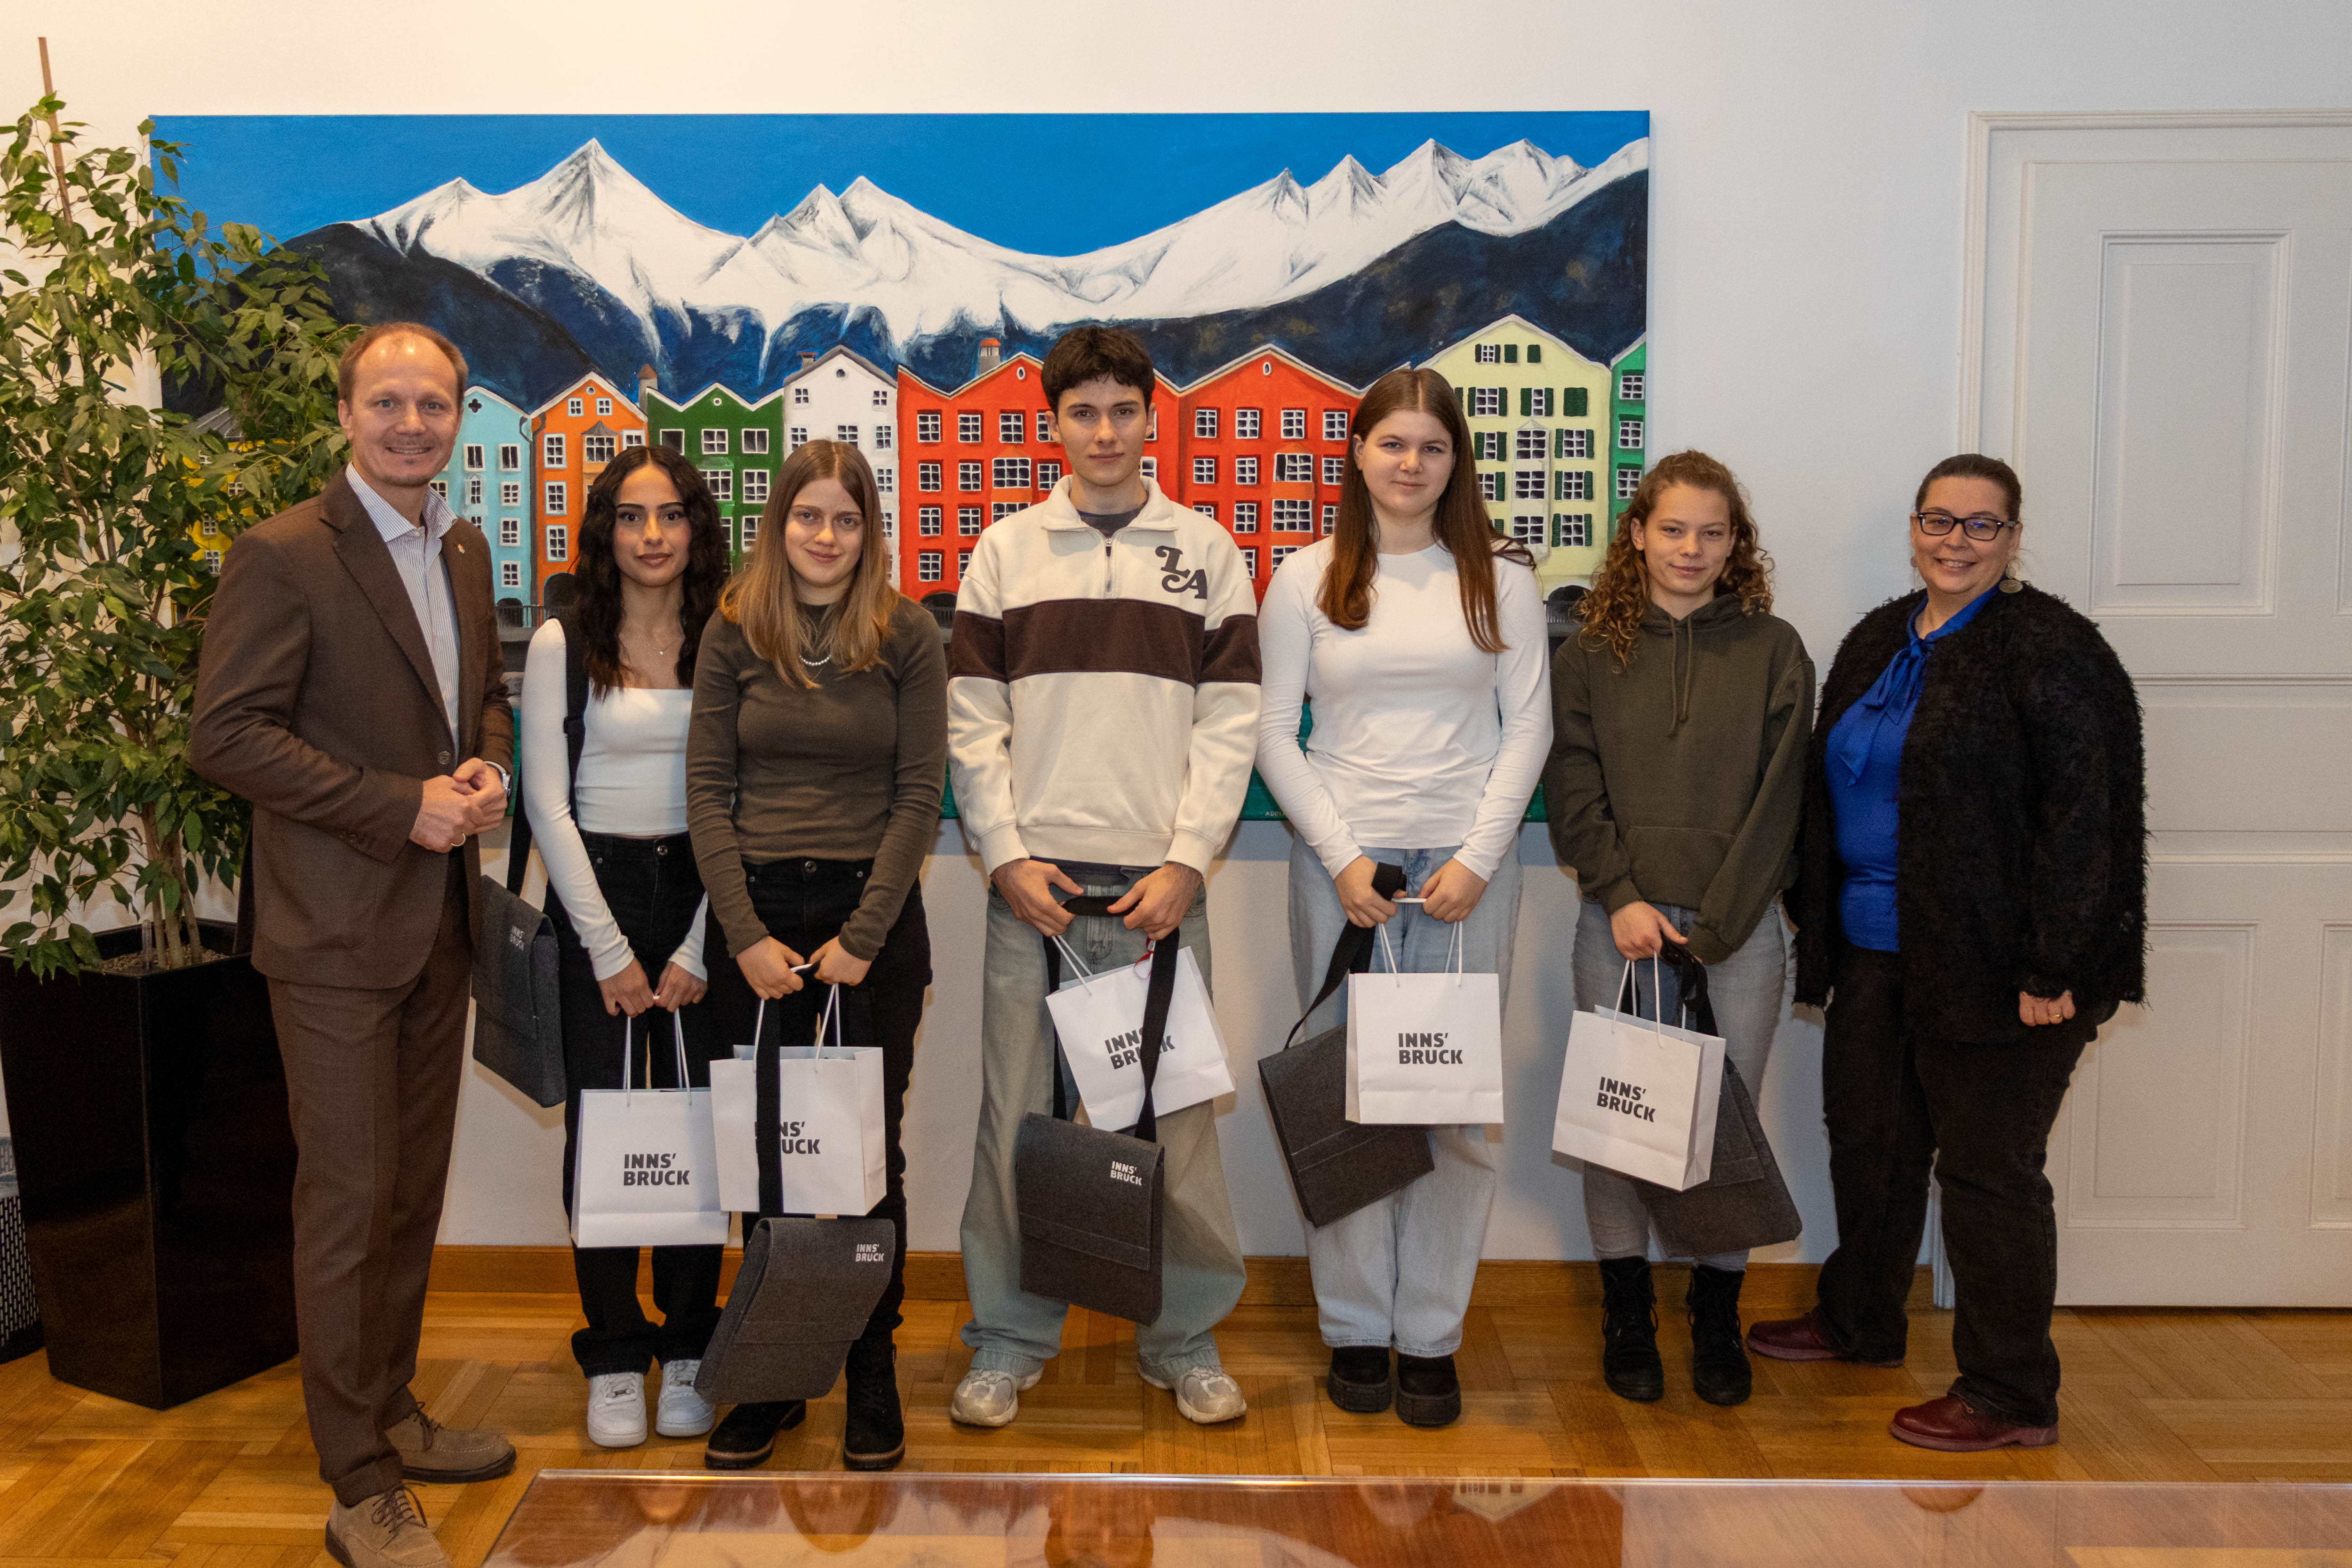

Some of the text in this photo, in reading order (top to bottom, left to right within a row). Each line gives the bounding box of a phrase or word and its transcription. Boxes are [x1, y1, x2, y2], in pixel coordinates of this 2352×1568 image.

[1155, 545, 1208, 600] LA
[1104, 1027, 1143, 1054] INN
[1399, 1033, 1448, 1048] INNS'
[1110, 1035, 1176, 1070] BRK
[1399, 1049, 1464, 1064] BRUCK
[1599, 1076, 1647, 1101] INNS'
[1596, 1092, 1656, 1123] BRUCK
[756, 1138, 820, 1154] UCK
[624, 1153, 677, 1169] INNS'
[1111, 1160, 1137, 1175] INNS'
[624, 1170, 690, 1186] BRUCK
[1110, 1169, 1143, 1186] BRUCK
[856, 1243, 880, 1252] INNS'
[856, 1253, 885, 1262] BRUCK
